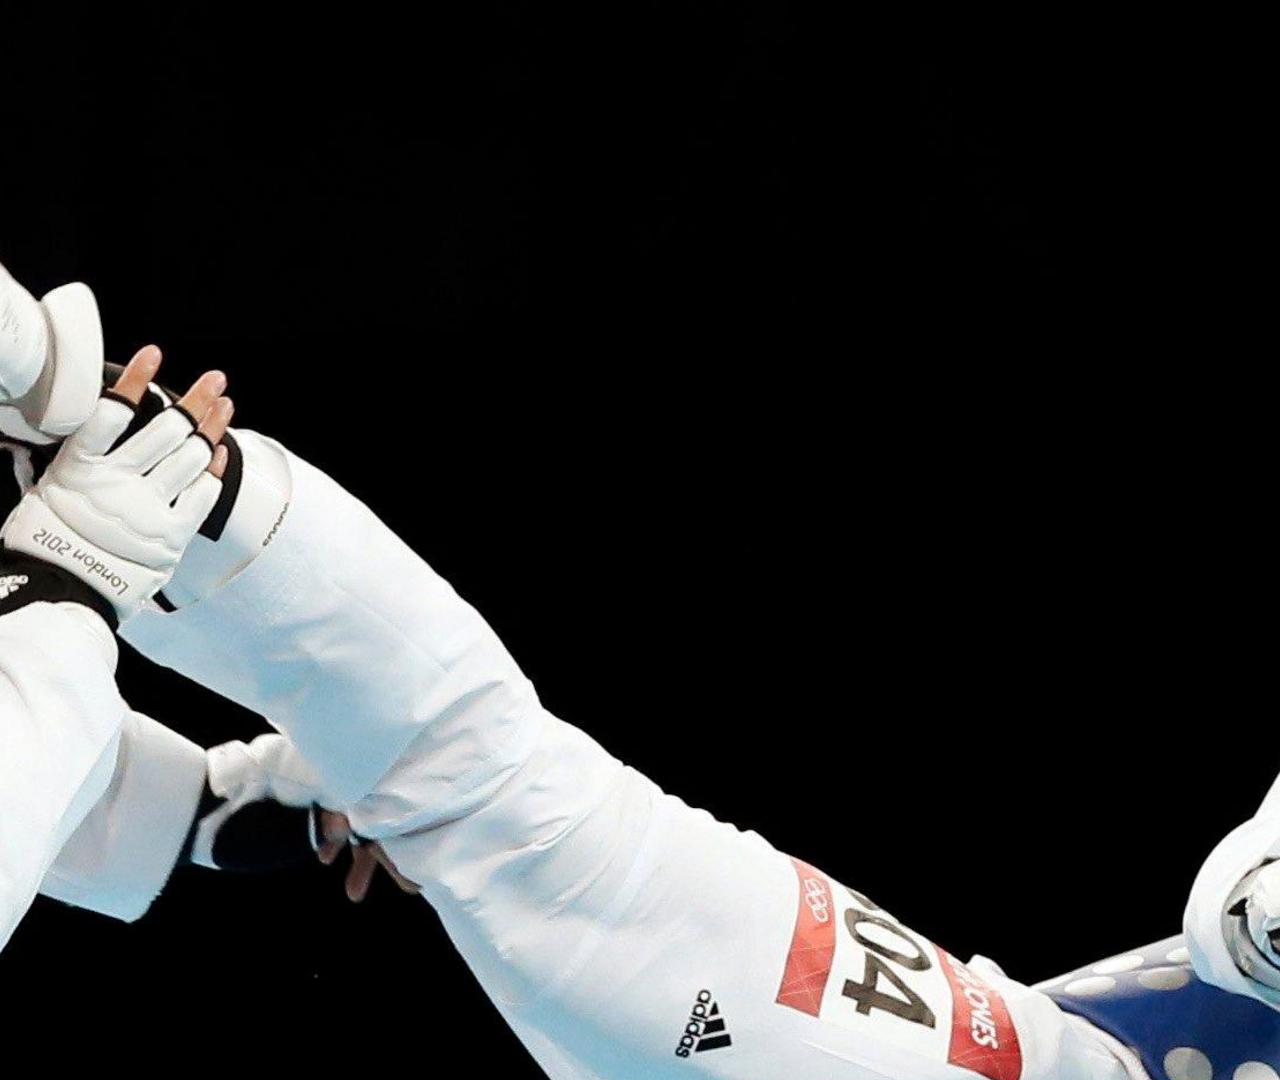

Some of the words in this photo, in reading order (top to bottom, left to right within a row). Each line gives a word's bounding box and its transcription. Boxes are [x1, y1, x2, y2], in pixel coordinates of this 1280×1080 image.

[32, 528, 72, 556] 2012
[73, 549, 129, 595] London
[841, 888, 937, 1030] 04
[675, 989, 712, 1058] adidas
